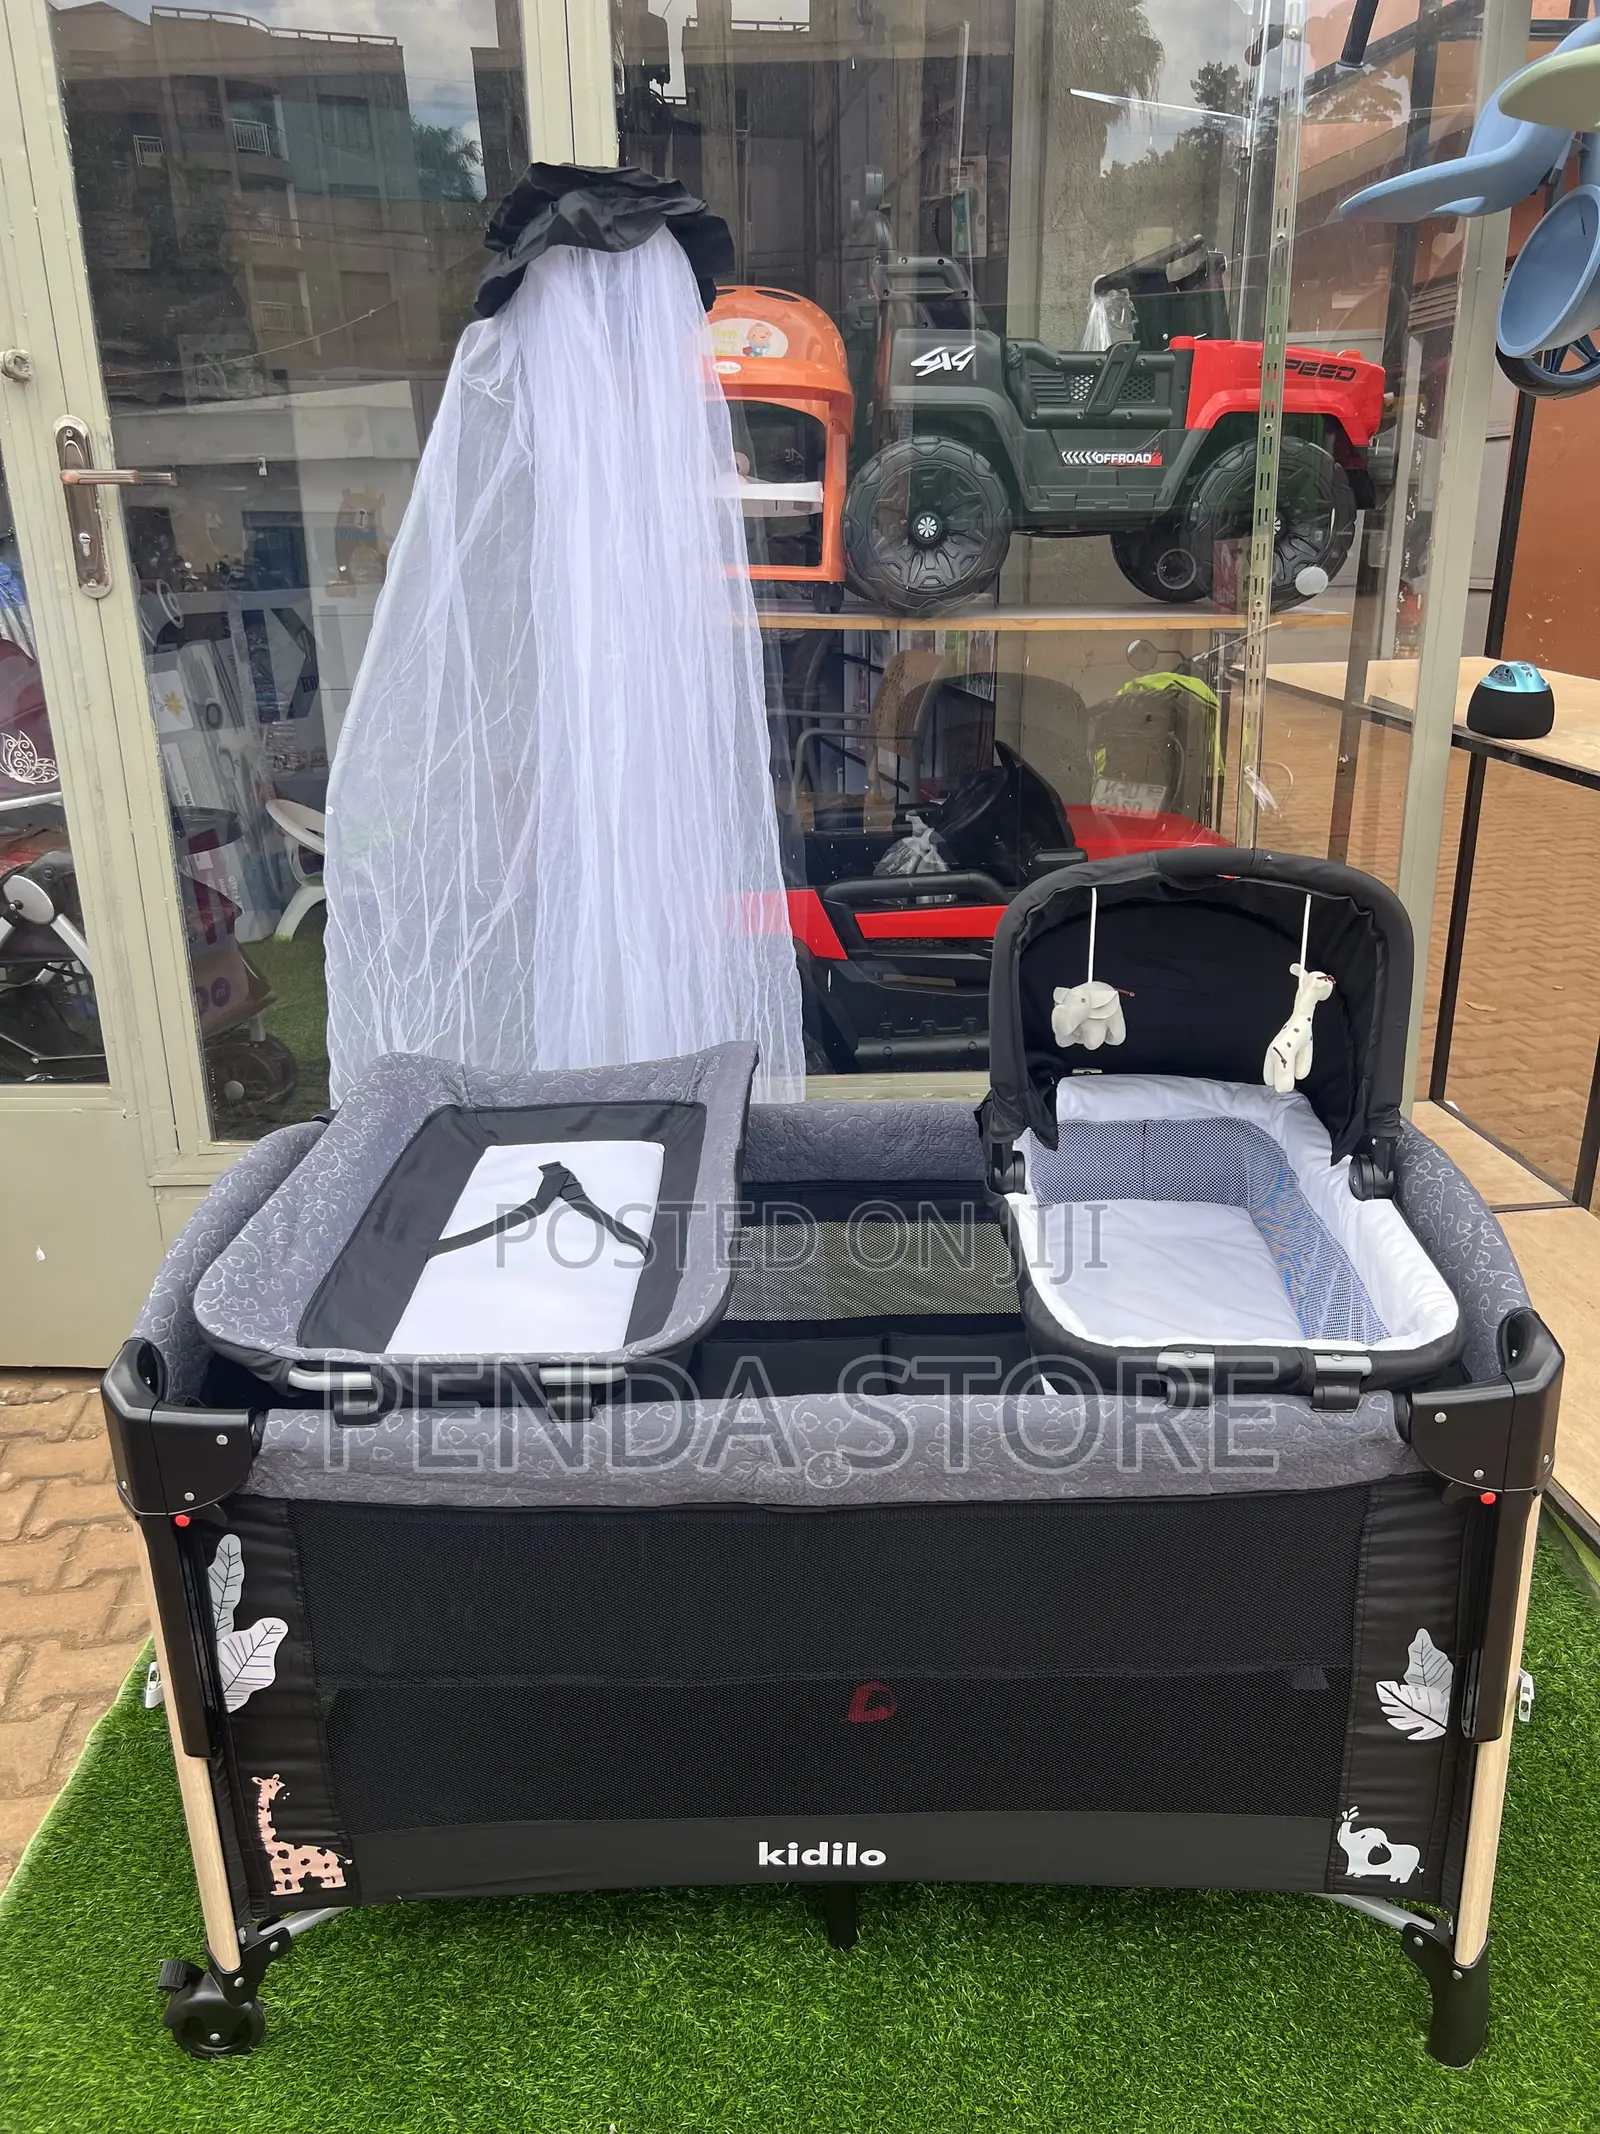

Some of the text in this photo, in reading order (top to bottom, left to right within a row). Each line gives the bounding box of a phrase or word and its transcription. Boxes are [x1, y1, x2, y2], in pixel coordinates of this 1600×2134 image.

[1258, 358, 1357, 382] PEED
[1095, 453, 1152, 464] OFFROAD
[758, 1841, 887, 1866] kidilo
